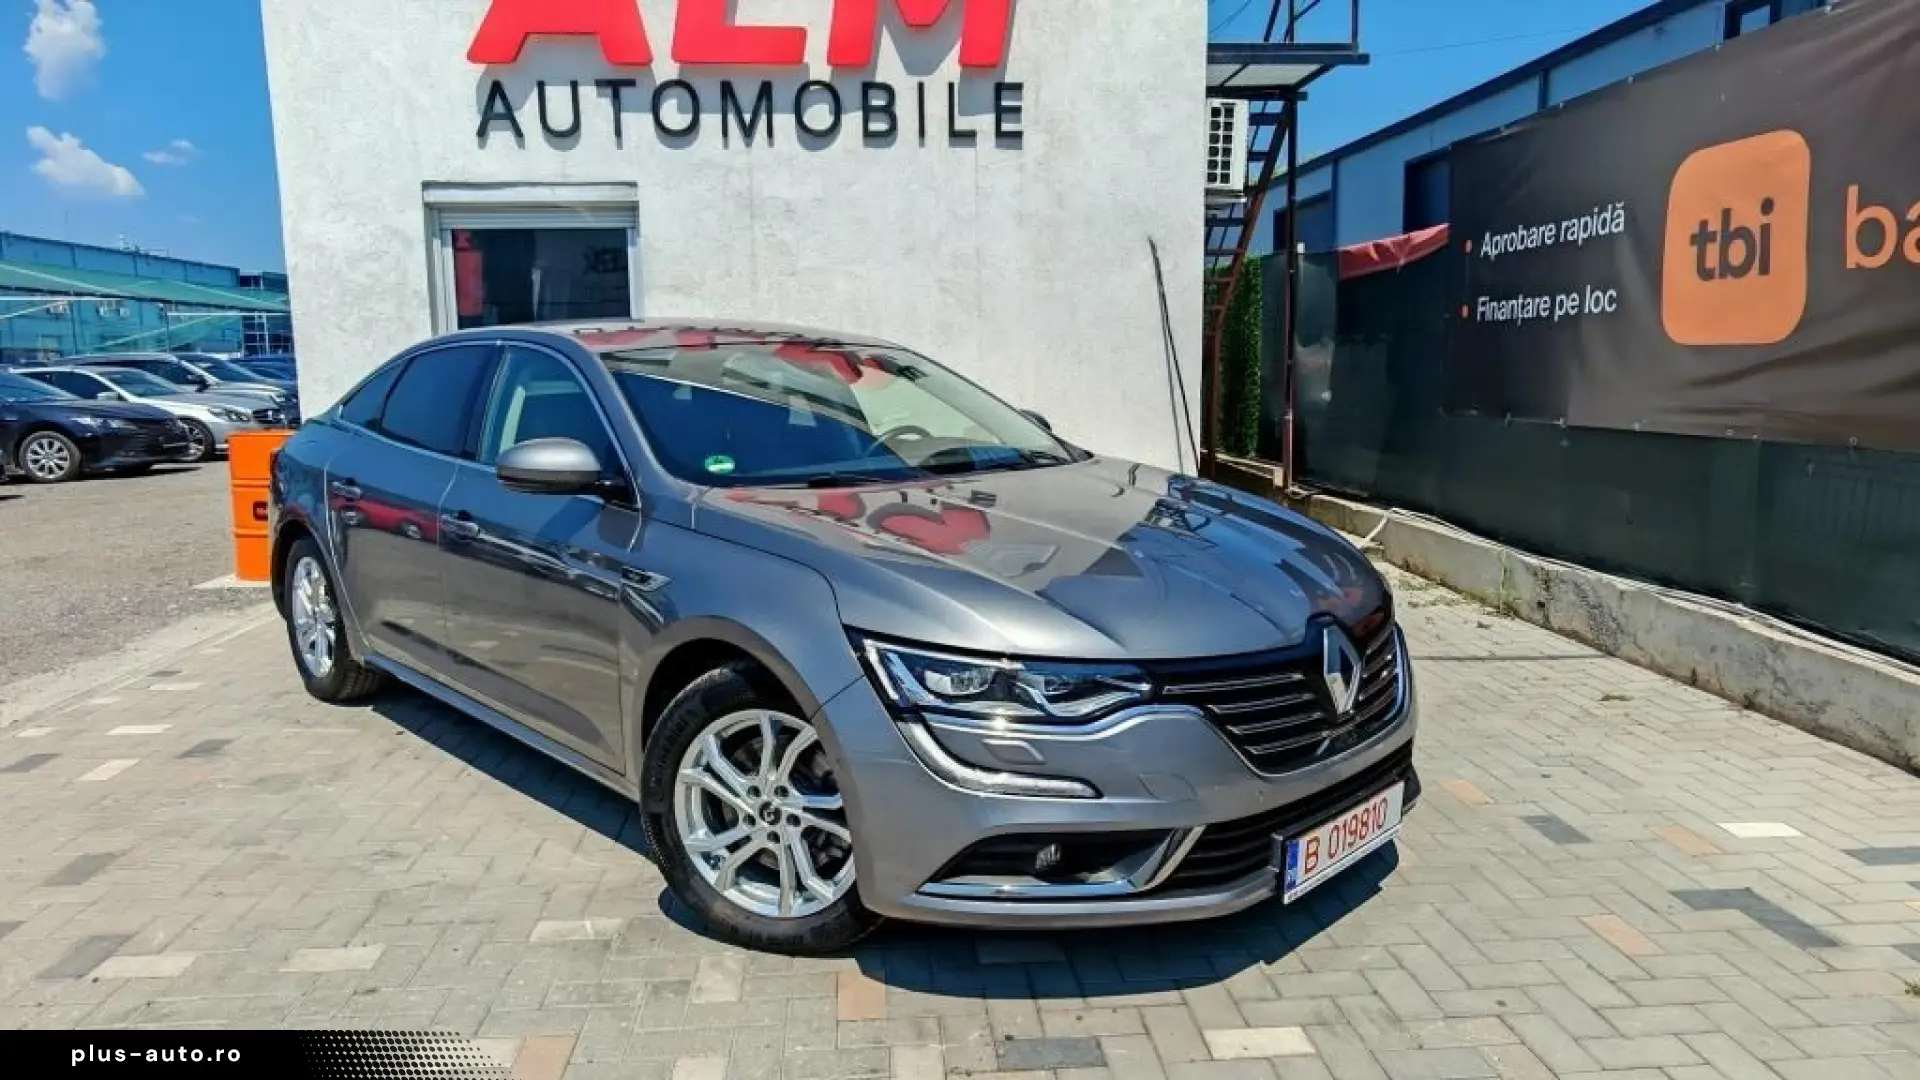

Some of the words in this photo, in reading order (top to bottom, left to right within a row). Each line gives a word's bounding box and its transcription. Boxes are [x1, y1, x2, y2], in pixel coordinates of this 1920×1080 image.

[476, 79, 1024, 138] AUTOMOBILE
[1480, 223, 1556, 261] Aprobare
[1559, 201, 1625, 247] rapidă
[1689, 196, 1774, 281] tbi
[1477, 293, 1551, 327] Finanțare
[1554, 292, 1580, 323] pe
[1584, 284, 1617, 314] loc
[1304, 835, 1320, 874] B
